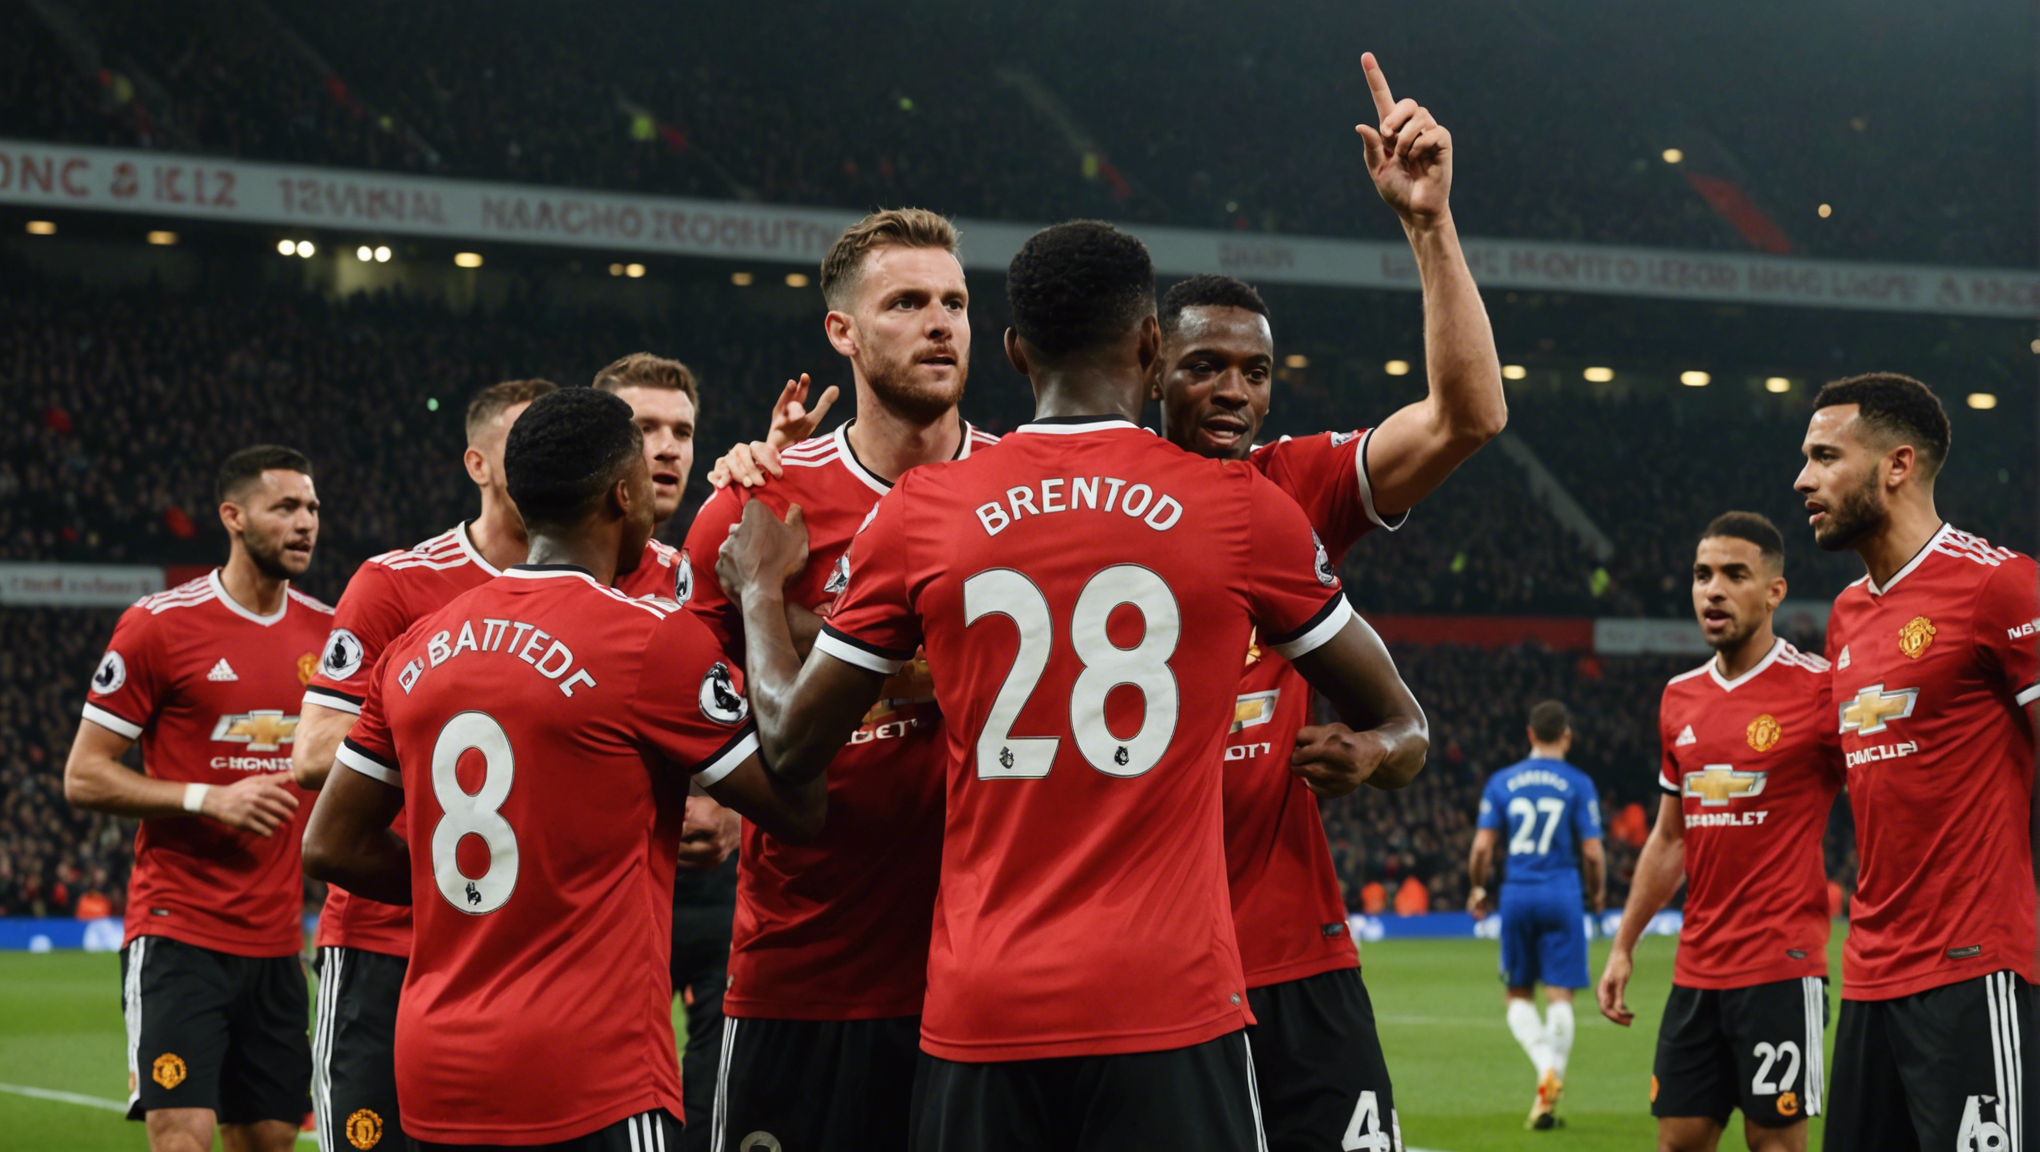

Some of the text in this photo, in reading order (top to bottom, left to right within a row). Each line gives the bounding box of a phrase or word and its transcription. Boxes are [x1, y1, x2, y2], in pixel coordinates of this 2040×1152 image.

[975, 476, 1183, 537] BRENTOD
[962, 562, 1182, 780] 28
[431, 709, 519, 915] 8
[1507, 797, 1565, 856] 27
